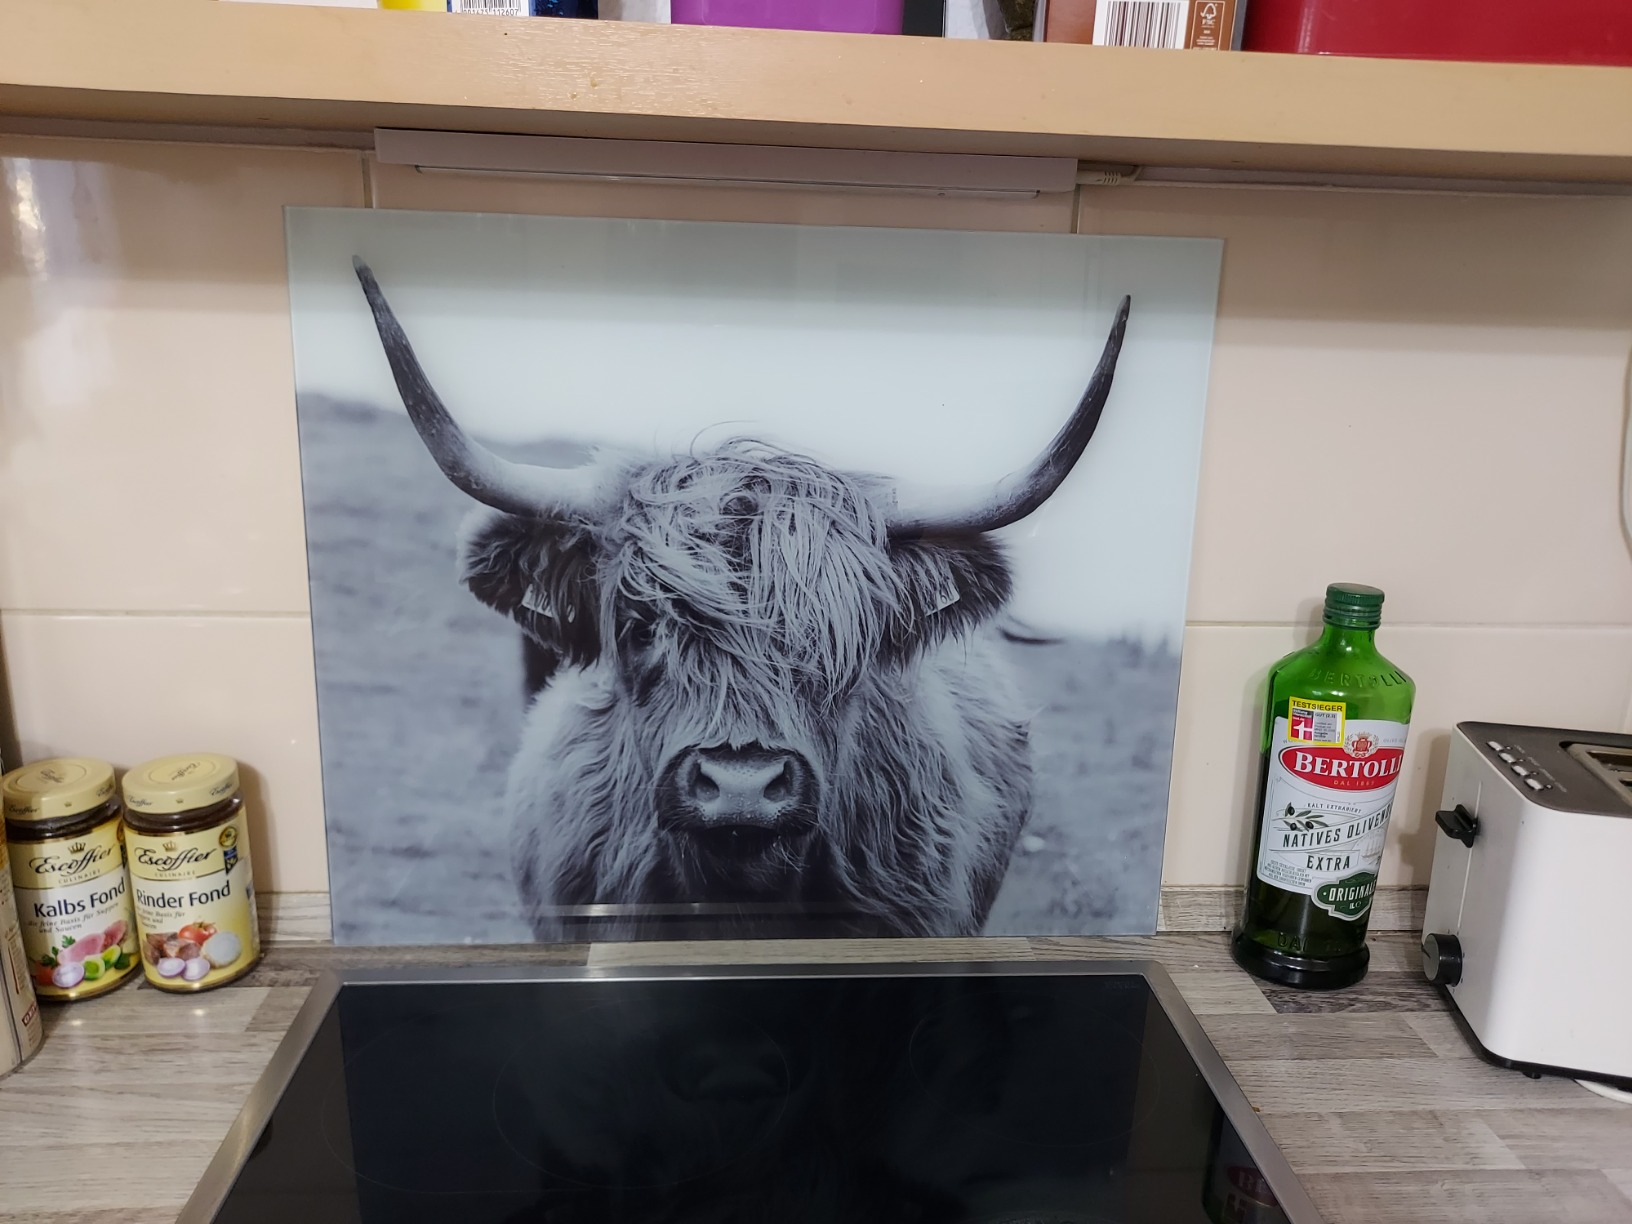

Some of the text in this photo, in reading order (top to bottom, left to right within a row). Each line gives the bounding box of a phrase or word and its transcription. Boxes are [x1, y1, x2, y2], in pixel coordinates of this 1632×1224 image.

[1292, 700, 1343, 711] TESTSIEGER
[1294, 751, 1402, 778] BERTOLLI
[1283, 828, 1341, 847] NATIVES
[29, 844, 116, 876] Escoffier
[134, 847, 217, 871] Escoffier
[1306, 855, 1350, 871] EXTRA
[34, 876, 125, 918] Kalbs Fond
[136, 879, 231, 908] Rinder Fond
